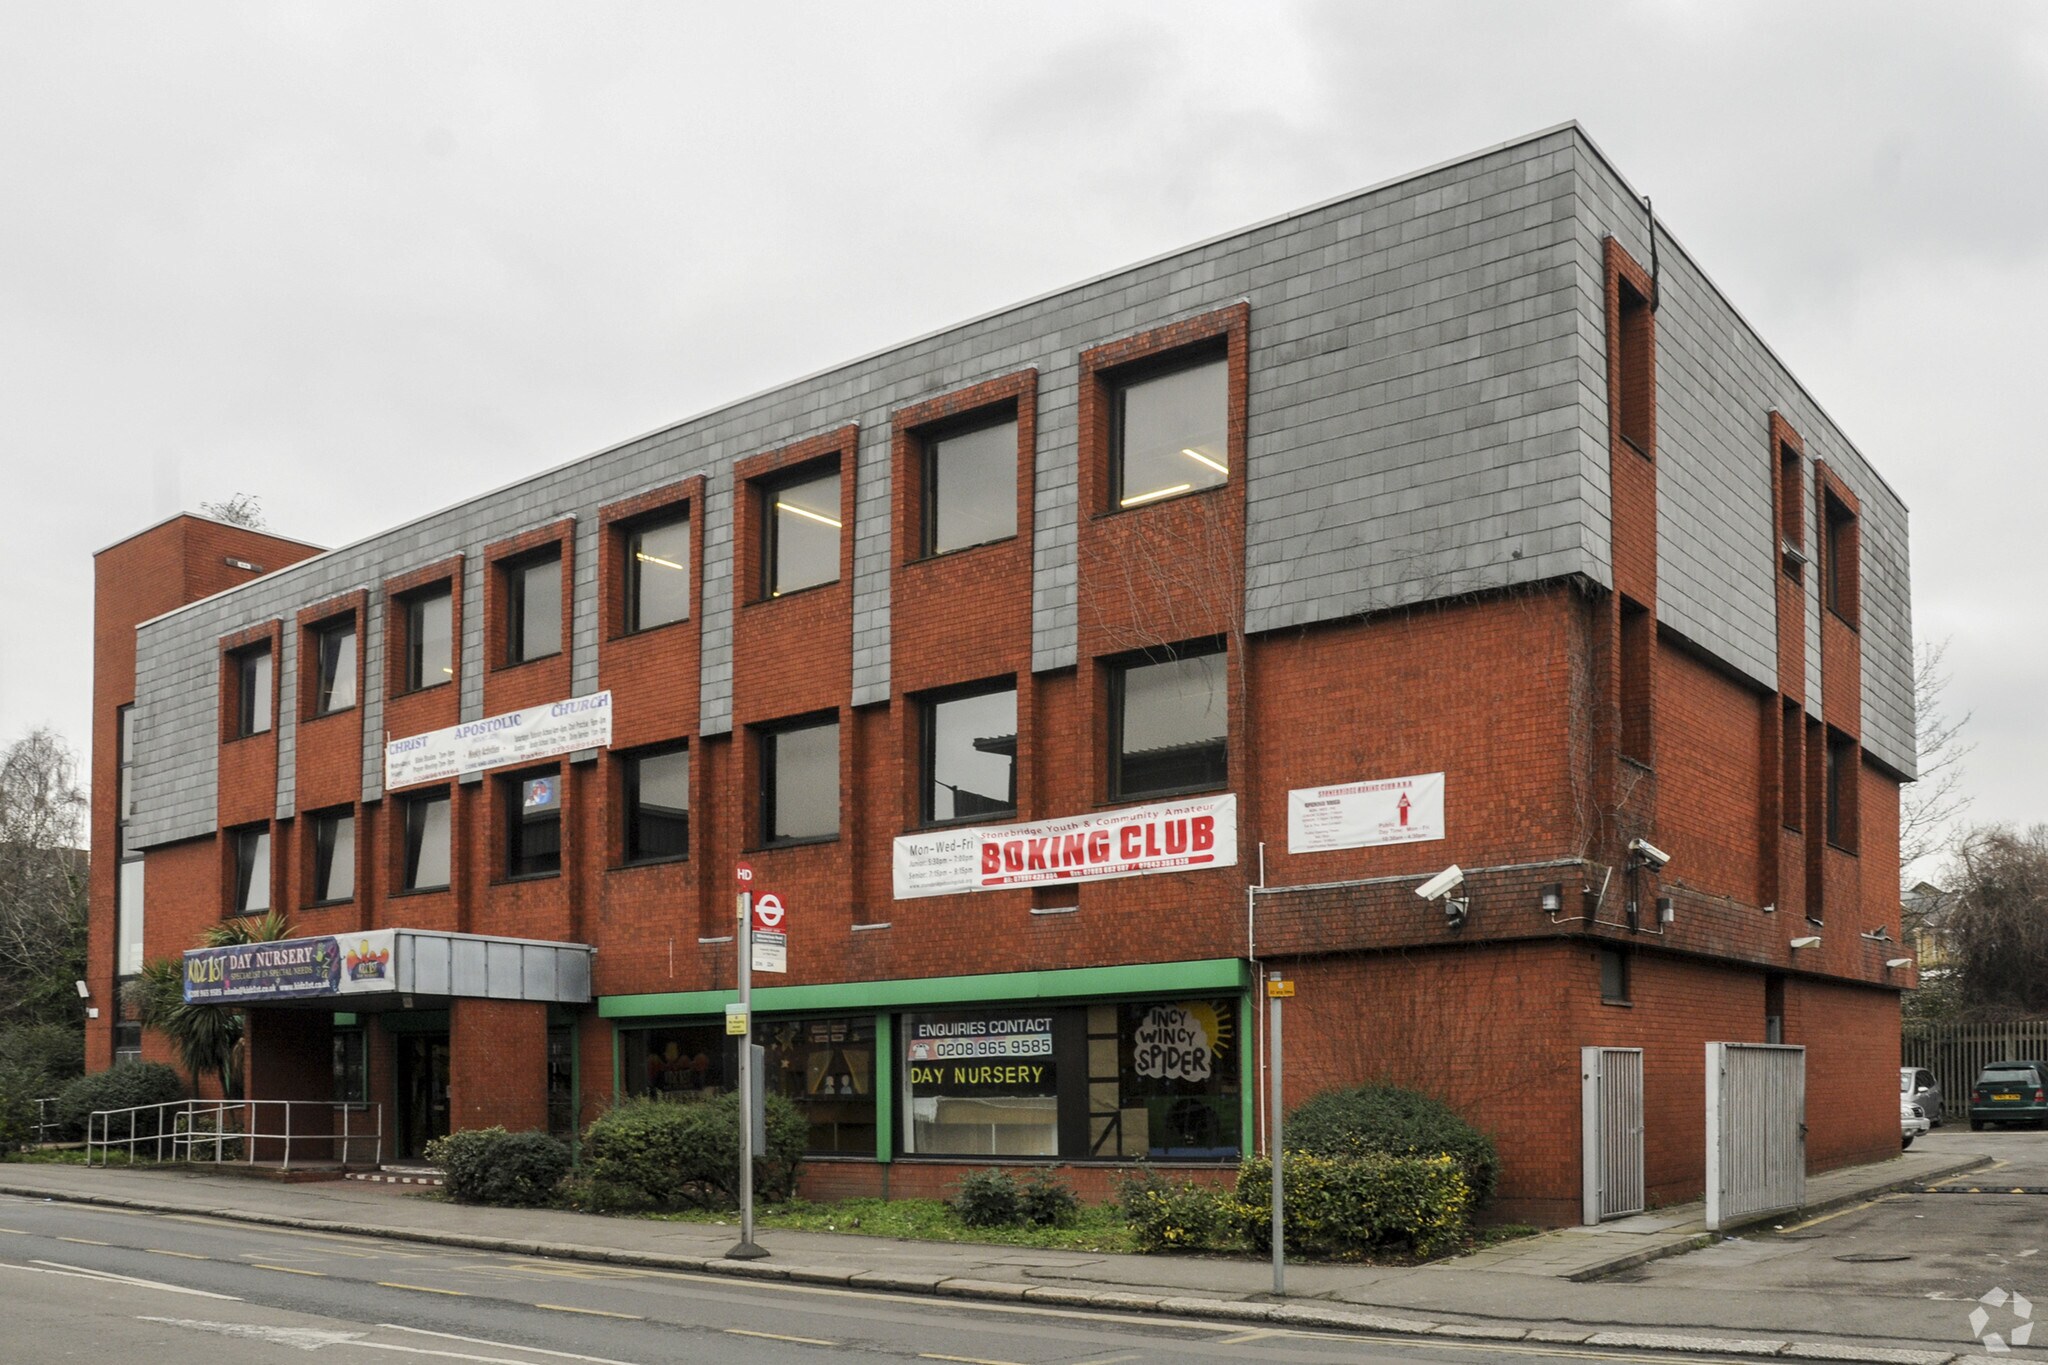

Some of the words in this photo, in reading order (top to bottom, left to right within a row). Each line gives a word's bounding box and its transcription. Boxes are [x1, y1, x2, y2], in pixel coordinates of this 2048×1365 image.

[389, 736, 428, 755] CHRIST
[454, 714, 521, 740] APOSTOLIC
[551, 694, 608, 717] CHURCH
[980, 828, 1042, 841] Stonebridge
[1047, 822, 1079, 833] Youth
[1084, 820, 1091, 828] &
[1096, 811, 1159, 827] Community
[1164, 804, 1215, 816] Amateur
[982, 830, 1110, 874] BOXING
[1120, 815, 1215, 860] CLUB
[737, 869, 752, 881] HD
[229, 953, 253, 970] DAY
[256, 947, 313, 968] NURSERY
[230, 970, 260, 980] SPECIALIST
[262, 970, 269, 978] IN
[269, 968, 293, 978] SPECIAL
[294, 966, 313, 976] NEEDS
[1151, 1009, 1187, 1026] INCY
[919, 1021, 987, 1038] ENQUIRIES
[989, 1018, 1053, 1035] CONTACT
[1139, 1028, 1196, 1046] WINCY
[936, 1041, 975, 1057] 0208
[978, 1040, 1007, 1056] 965
[1011, 1038, 1051, 1055] 9585
[1137, 1047, 1207, 1076] SPIDER
[911, 1067, 944, 1084] DAY
[954, 1066, 1044, 1084] NURSERY
